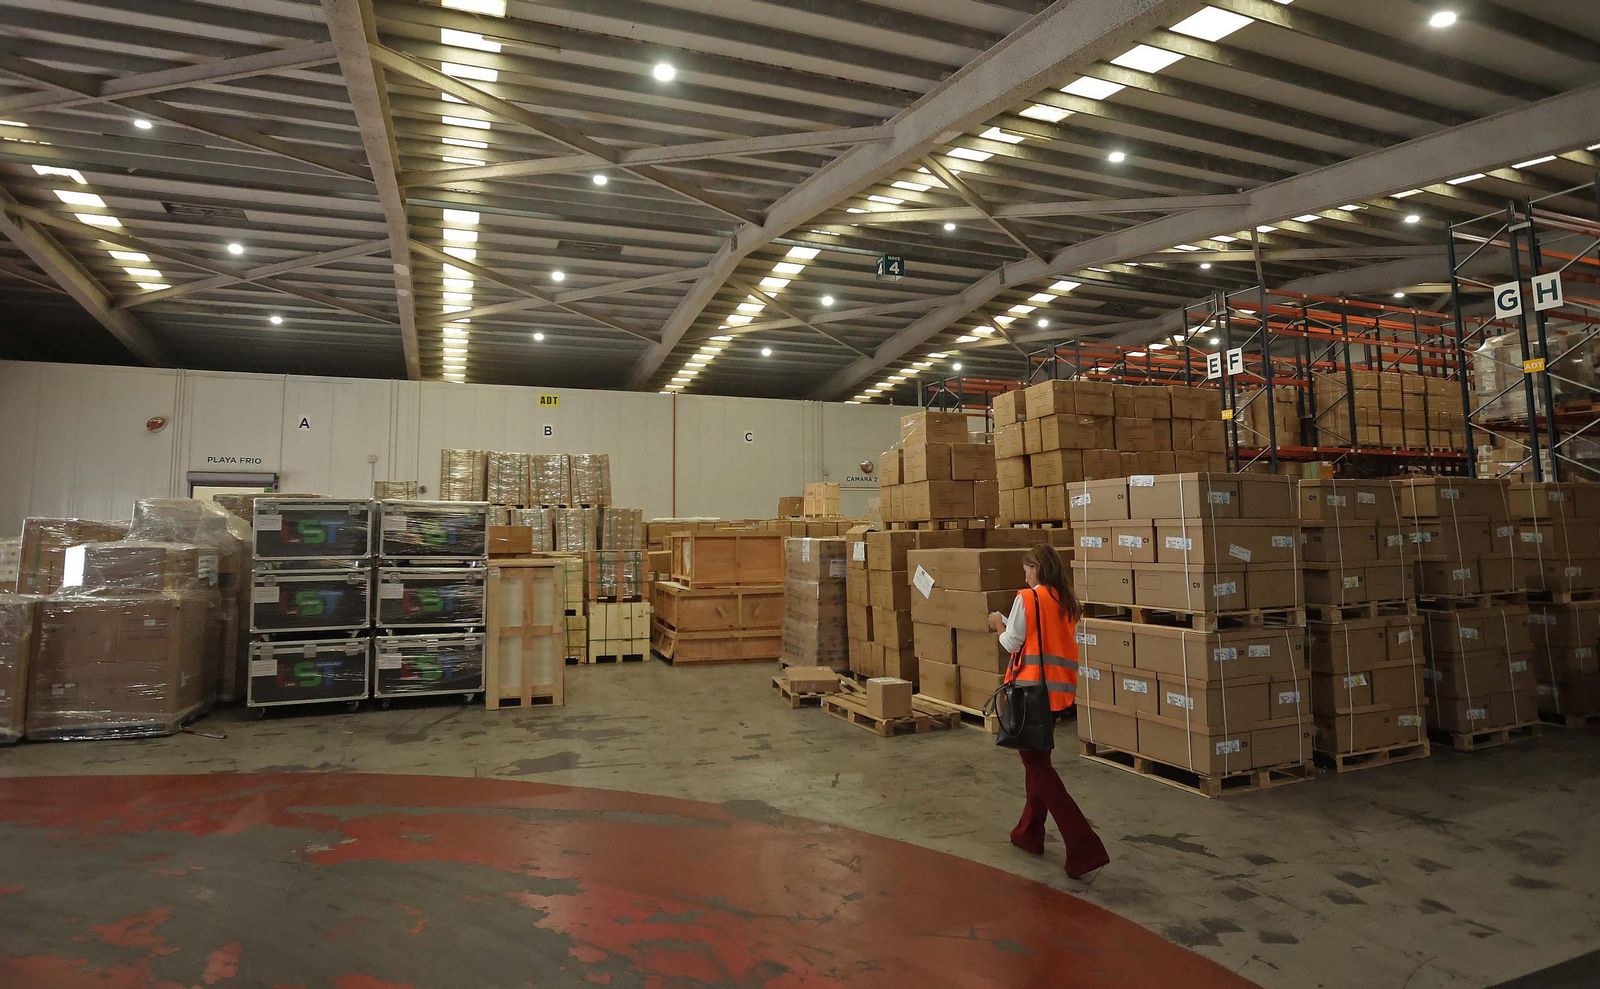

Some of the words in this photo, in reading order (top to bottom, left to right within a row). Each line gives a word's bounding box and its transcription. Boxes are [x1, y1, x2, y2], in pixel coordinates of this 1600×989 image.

[889, 261, 900, 275] 4
[1535, 279, 1558, 304] H
[1496, 289, 1518, 311] G
[1209, 357, 1219, 374] E
[1229, 352, 1239, 370] F
[1524, 361, 1544, 370] ADT
[540, 396, 558, 405] ADT
[299, 417, 310, 429] A
[544, 426, 552, 436] B
[745, 432, 753, 442] C
[207, 456, 237, 464] PLAYA
[239, 457, 262, 465] FRIO
[281, 519, 344, 545] LST
